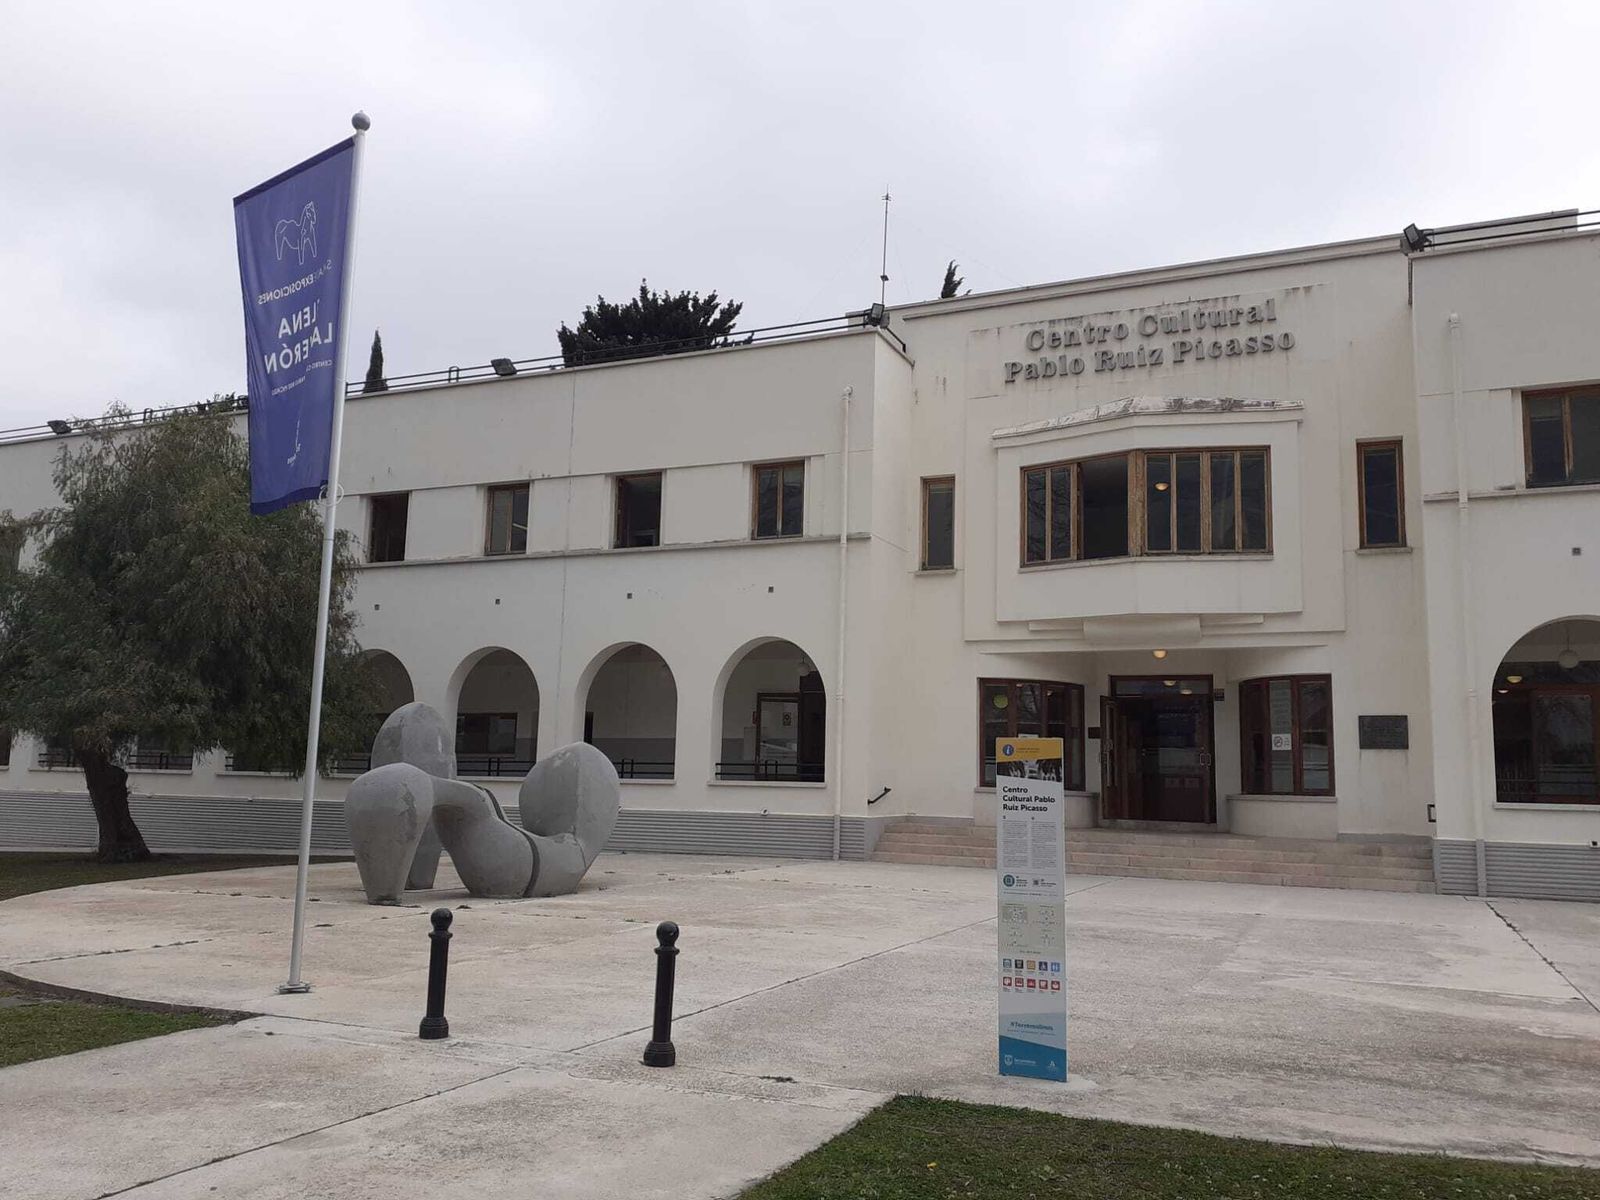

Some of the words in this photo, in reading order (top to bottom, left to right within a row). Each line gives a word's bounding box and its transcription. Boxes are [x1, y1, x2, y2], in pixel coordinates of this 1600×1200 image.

[1025, 320, 1129, 351] Centro
[1137, 299, 1277, 337] Cultural
[1004, 354, 1086, 384] Pablo
[1172, 331, 1296, 363] Picasso
[1002, 785, 1028, 794] Centro
[1002, 794, 1033, 803] Cultural
[1034, 795, 1056, 803] Pablo
[1002, 803, 1019, 811] Ruiz
[1020, 804, 1048, 812] Picasso
